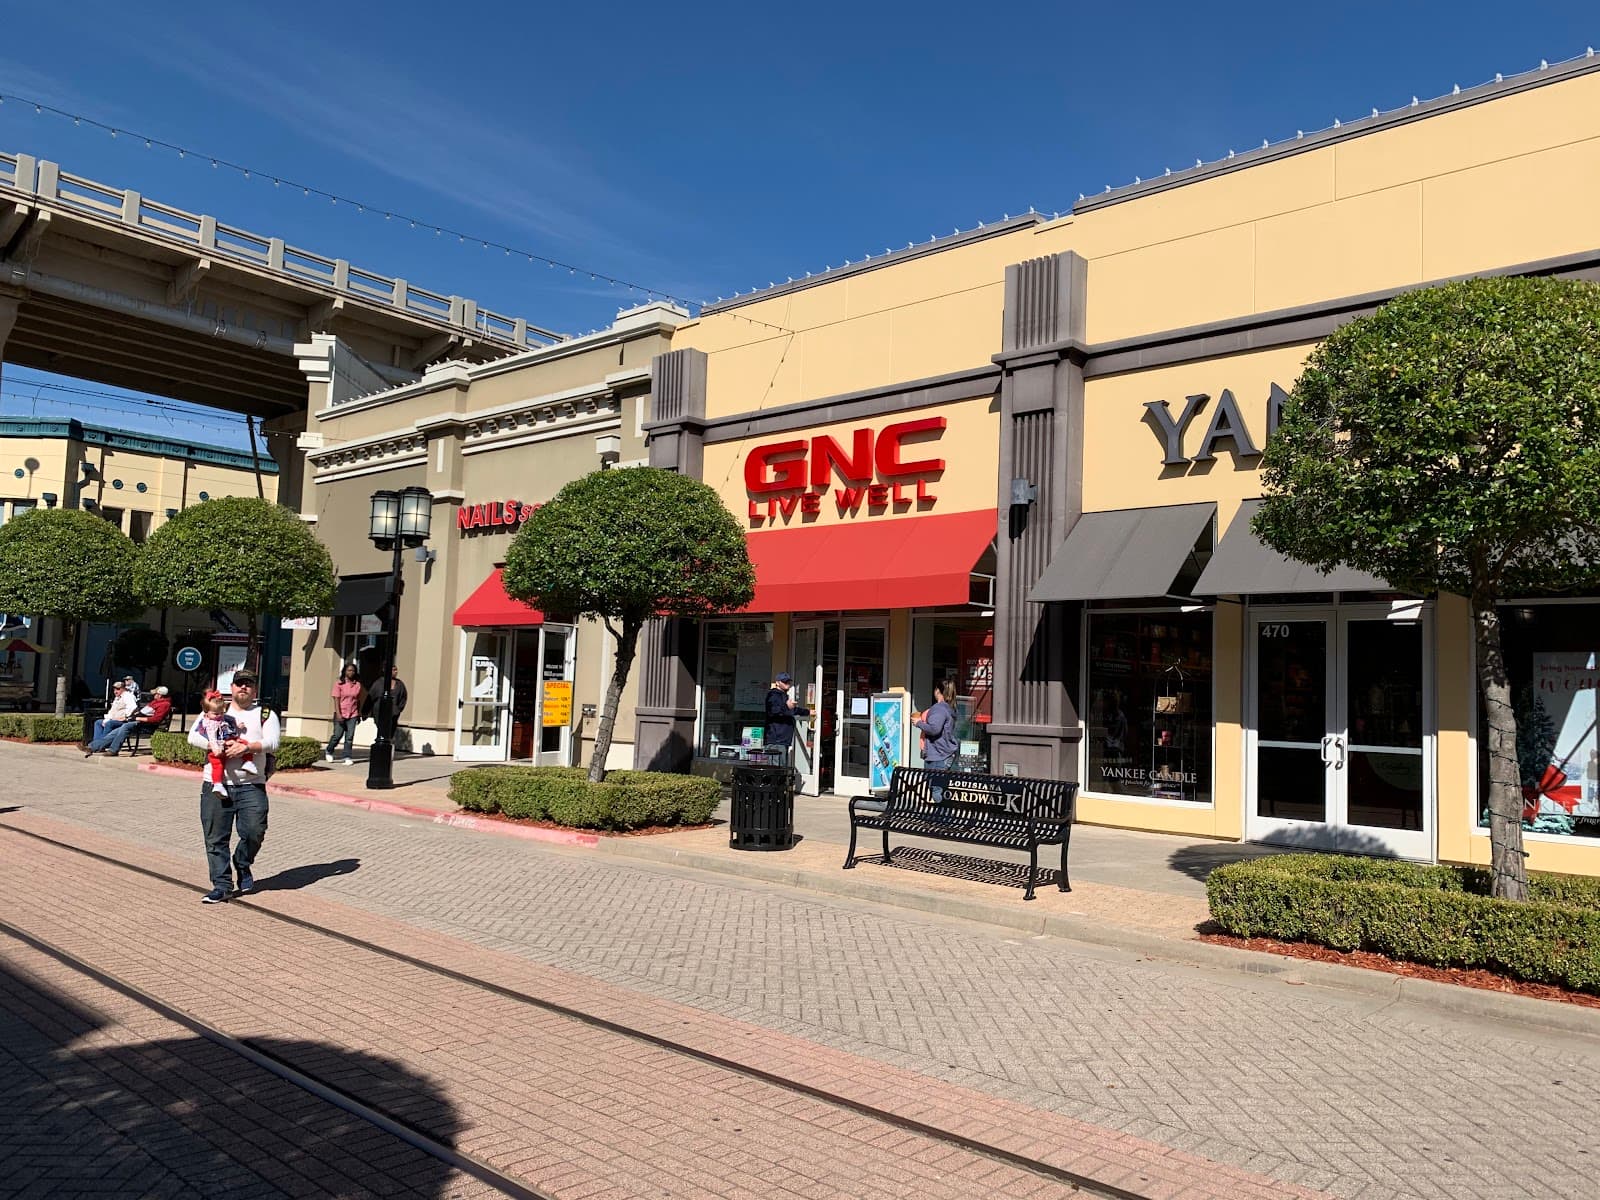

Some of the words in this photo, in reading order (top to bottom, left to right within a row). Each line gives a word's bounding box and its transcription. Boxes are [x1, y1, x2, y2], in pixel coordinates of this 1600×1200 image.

[744, 416, 947, 493] GNC
[749, 491, 820, 519] LIVE
[835, 479, 938, 509] WELL
[456, 500, 517, 530] NAILS
[1261, 624, 1290, 638] 470
[948, 779, 1002, 792] LOUISIANA
[1100, 766, 1146, 780] YANKEE
[1148, 769, 1198, 784] CANDLE
[926, 782, 1023, 814] BOARDWALK
[1523, 797, 1570, 813] NKEE
